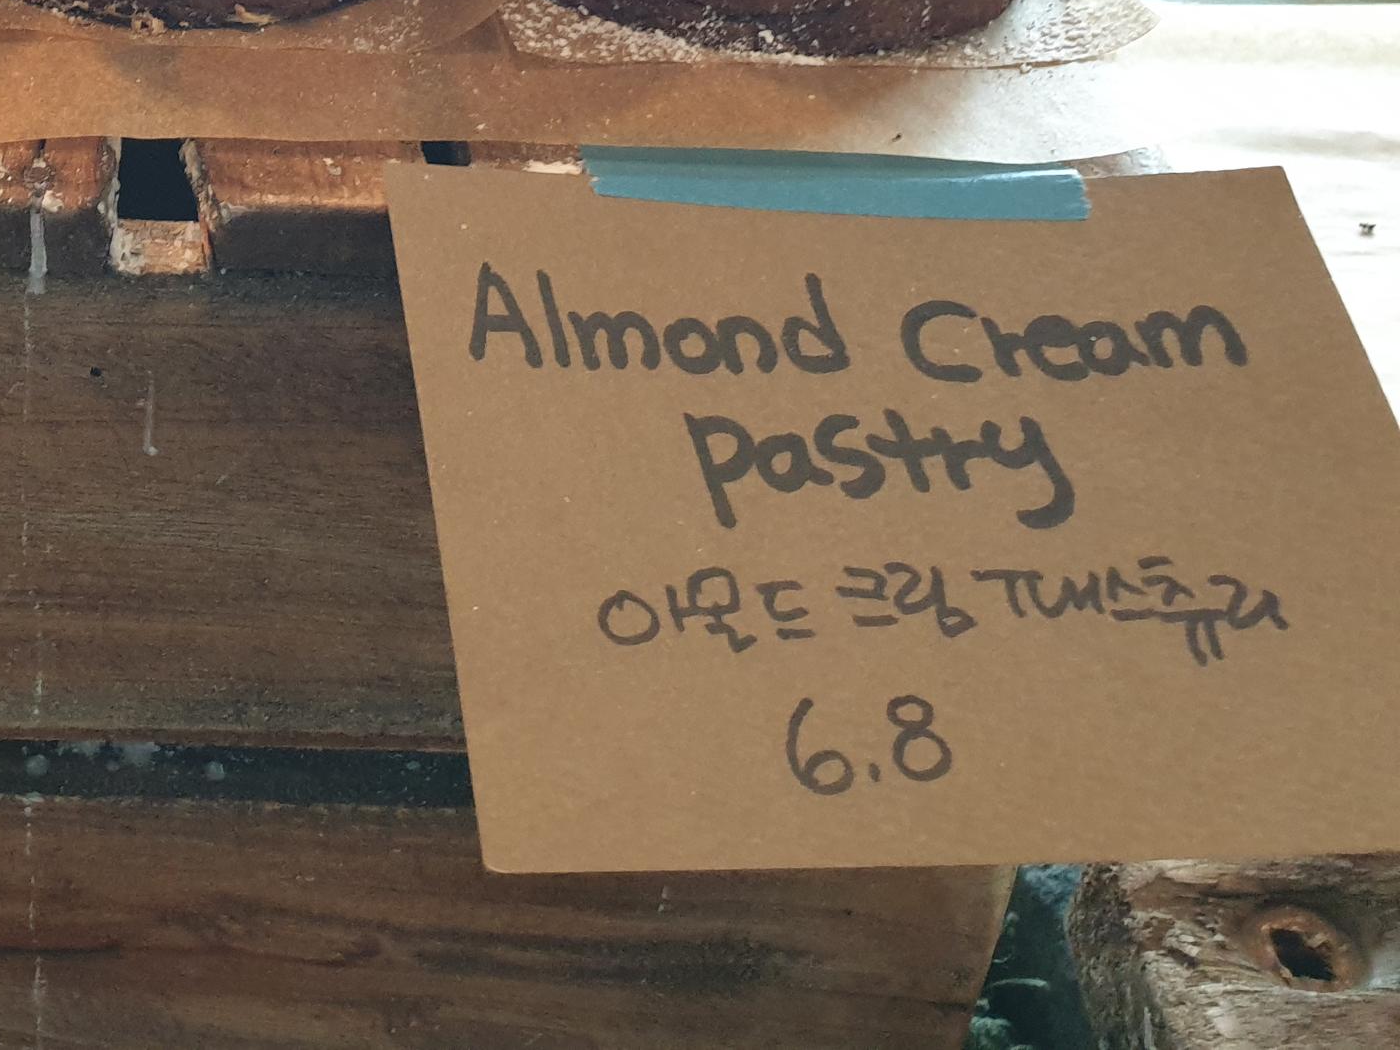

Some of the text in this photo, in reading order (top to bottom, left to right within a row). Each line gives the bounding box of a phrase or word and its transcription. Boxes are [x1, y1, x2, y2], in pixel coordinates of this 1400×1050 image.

[468, 261, 1249, 384] Almond Cream
[597, 555, 1290, 667] 아몬드 크림 패스츄리
[785, 694, 953, 796] 6.8
